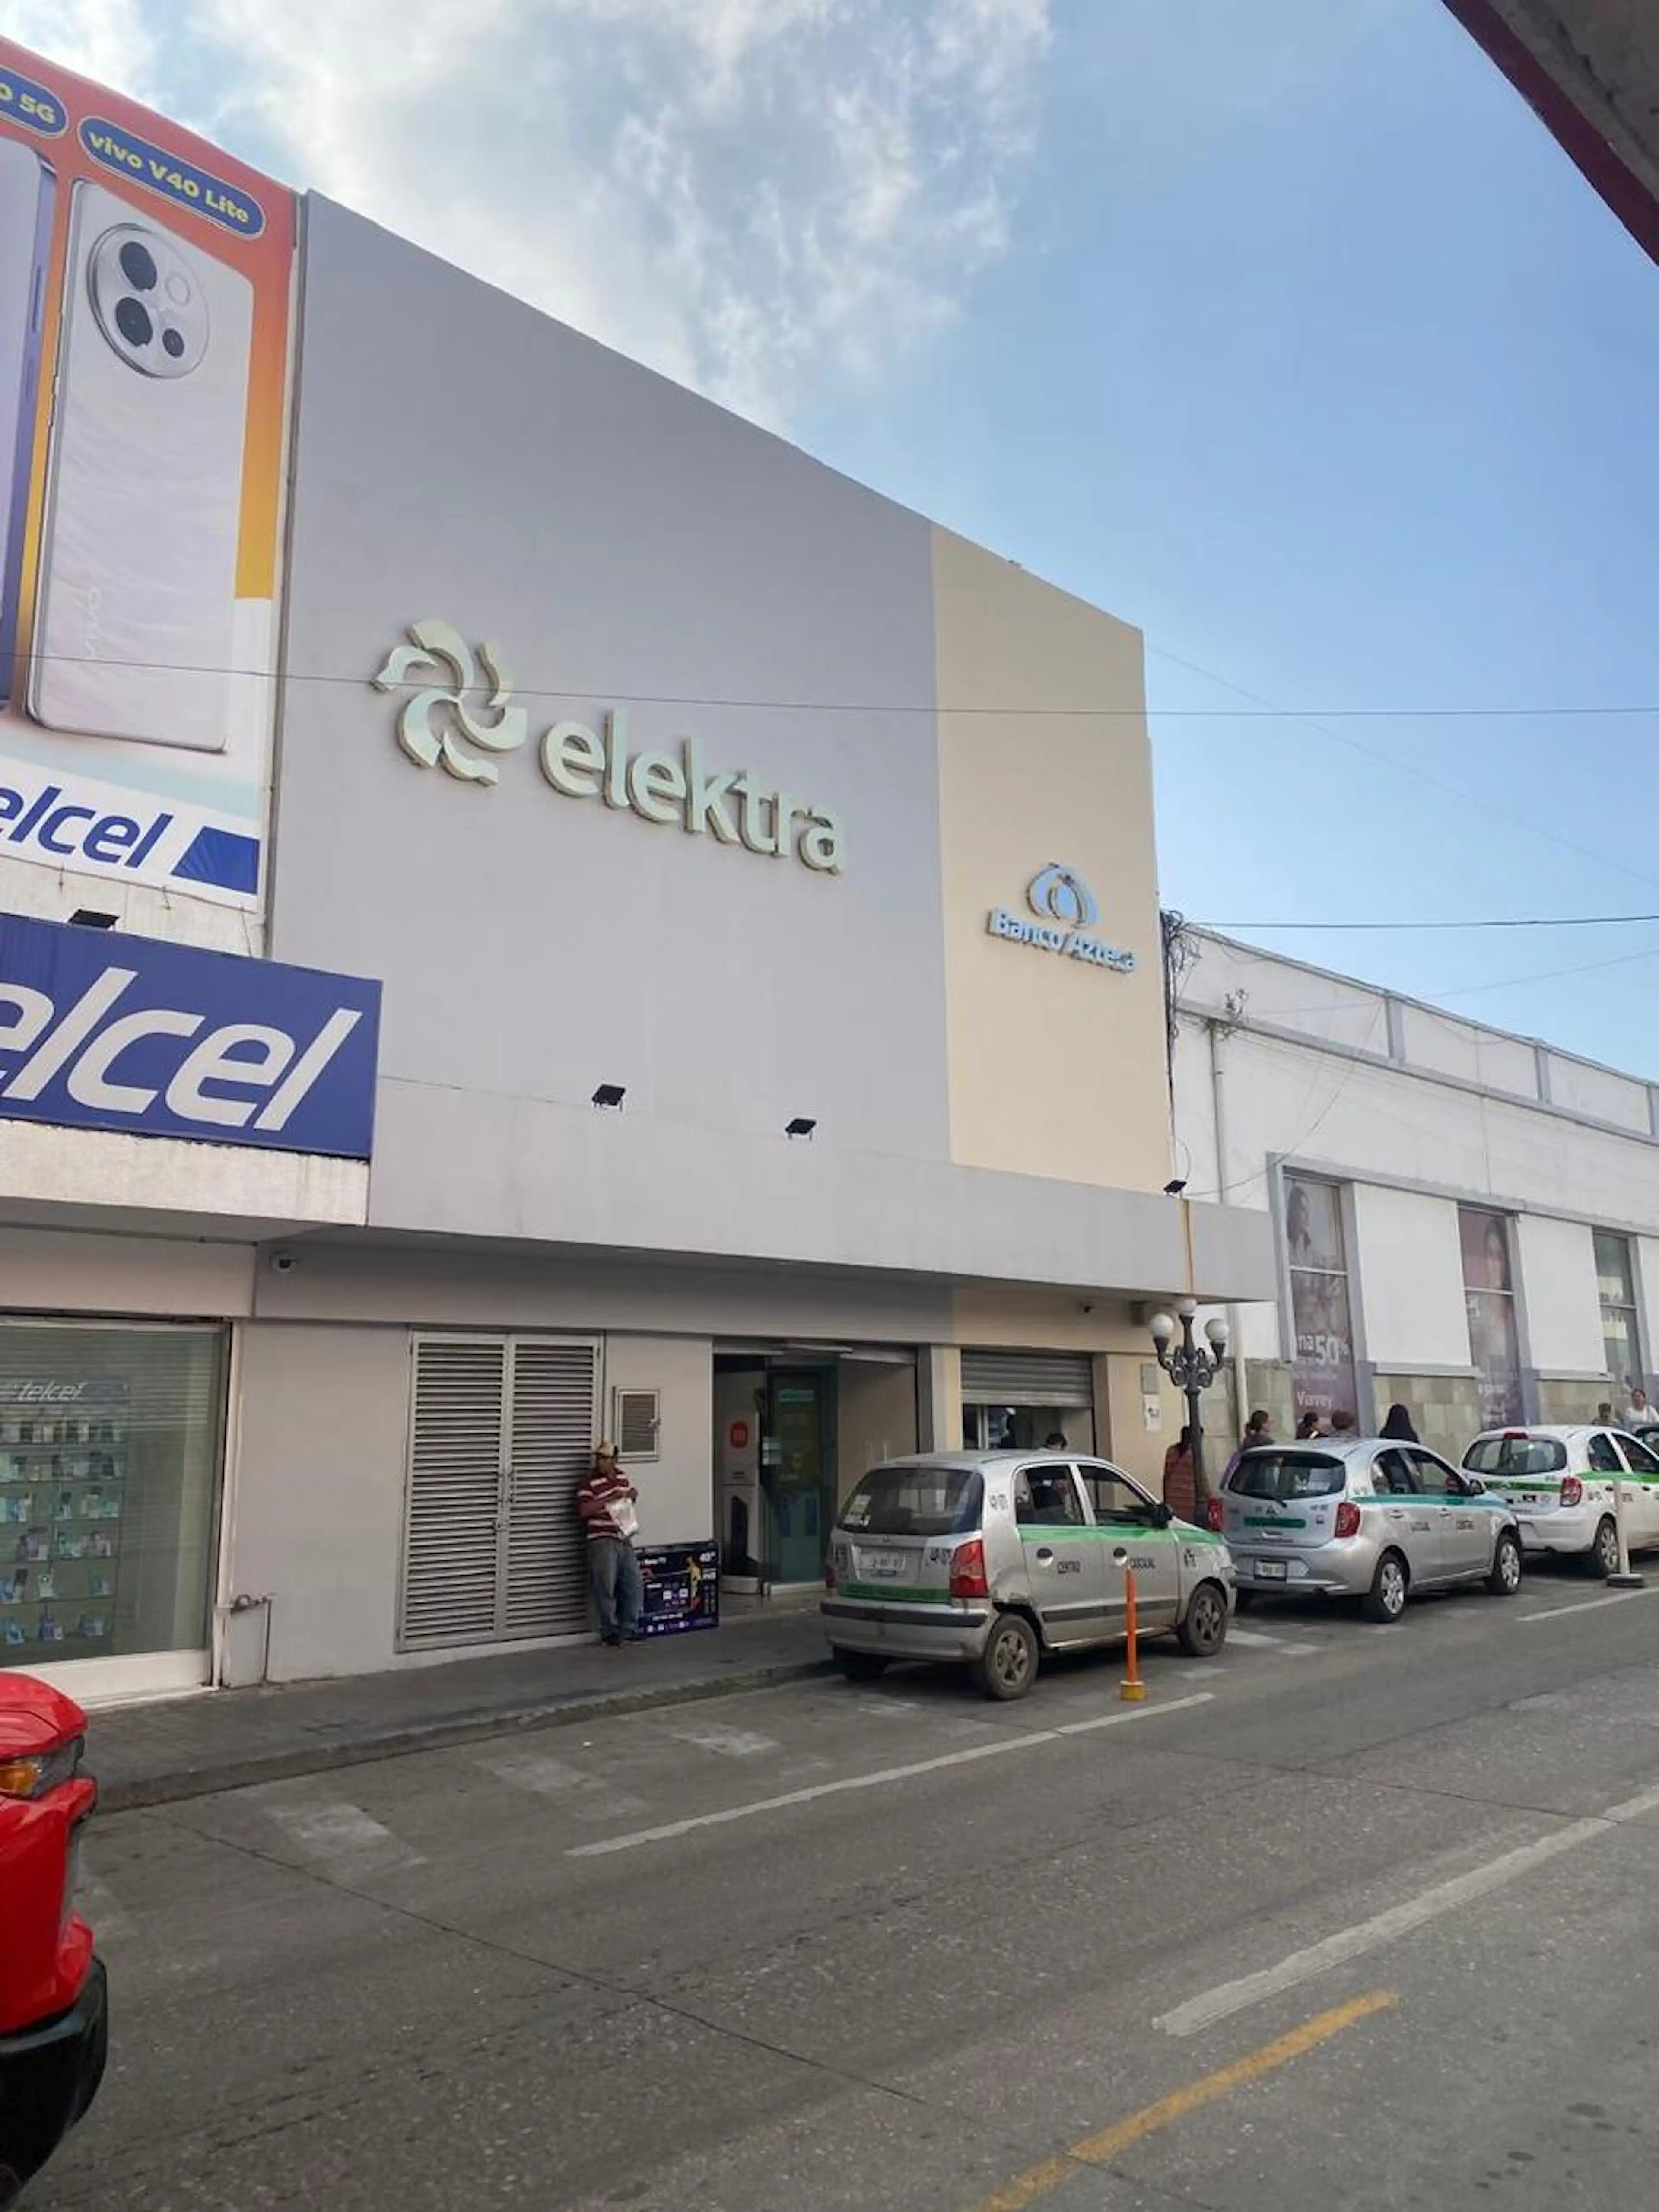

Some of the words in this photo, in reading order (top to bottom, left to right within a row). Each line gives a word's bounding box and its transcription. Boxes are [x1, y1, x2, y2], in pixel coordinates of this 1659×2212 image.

[19, 92, 56, 124] 5G
[89, 131, 143, 169] vivo
[149, 159, 200, 199] V40
[206, 188, 250, 224] Lite
[539, 708, 844, 874] elektra
[987, 908, 1062, 951] Banco
